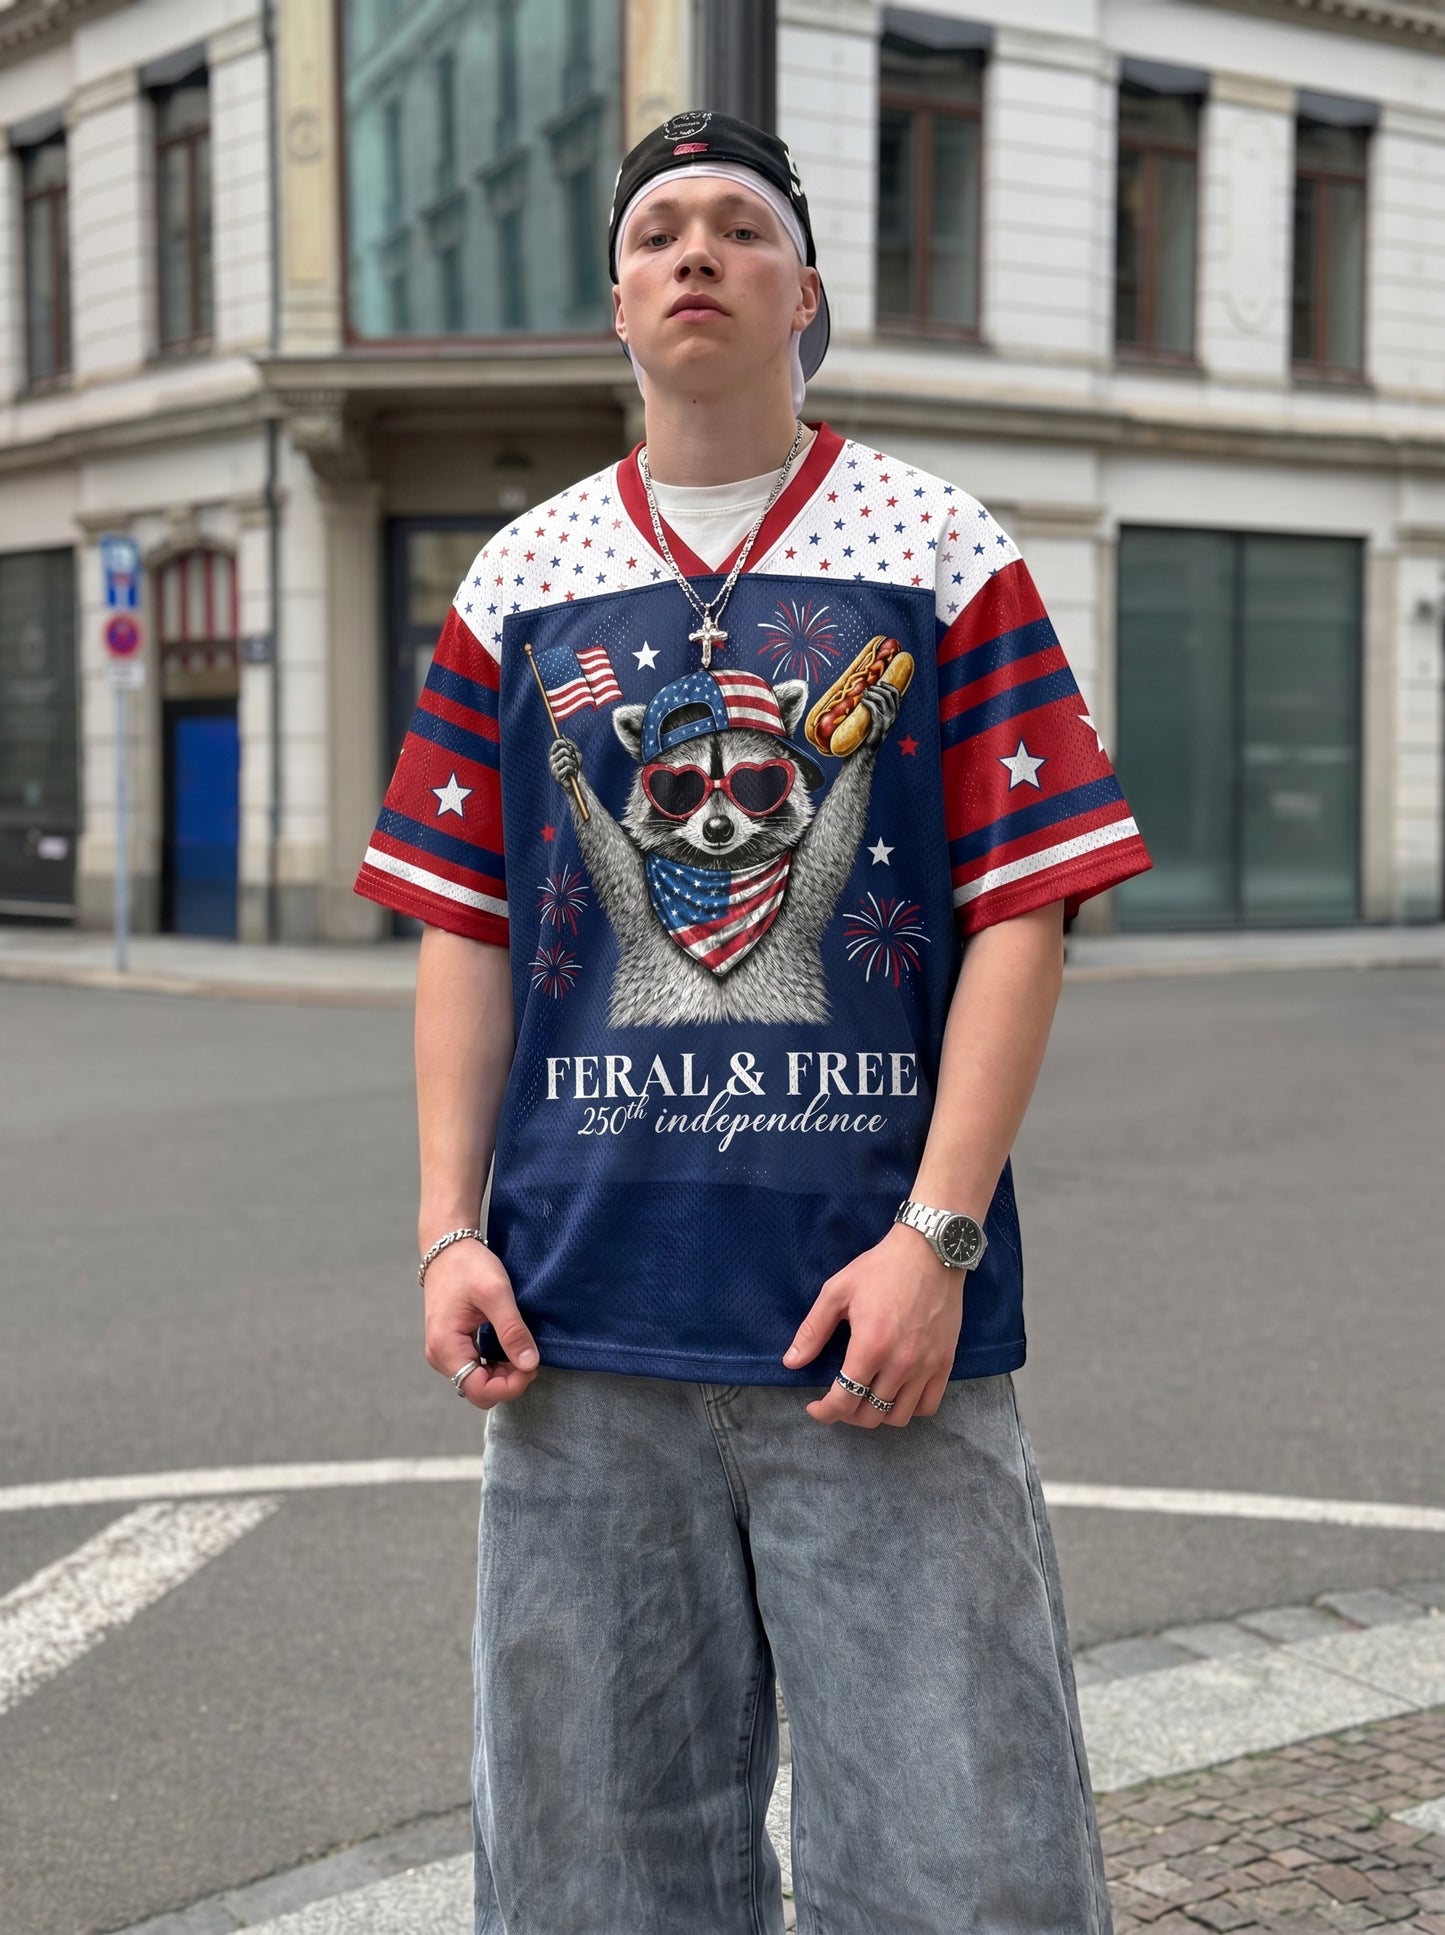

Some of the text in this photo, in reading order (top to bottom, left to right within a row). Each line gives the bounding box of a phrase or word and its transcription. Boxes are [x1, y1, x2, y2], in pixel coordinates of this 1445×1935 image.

[546, 1051, 918, 1100] FERAL & FREE
[577, 1090, 887, 1153] 250th independence
